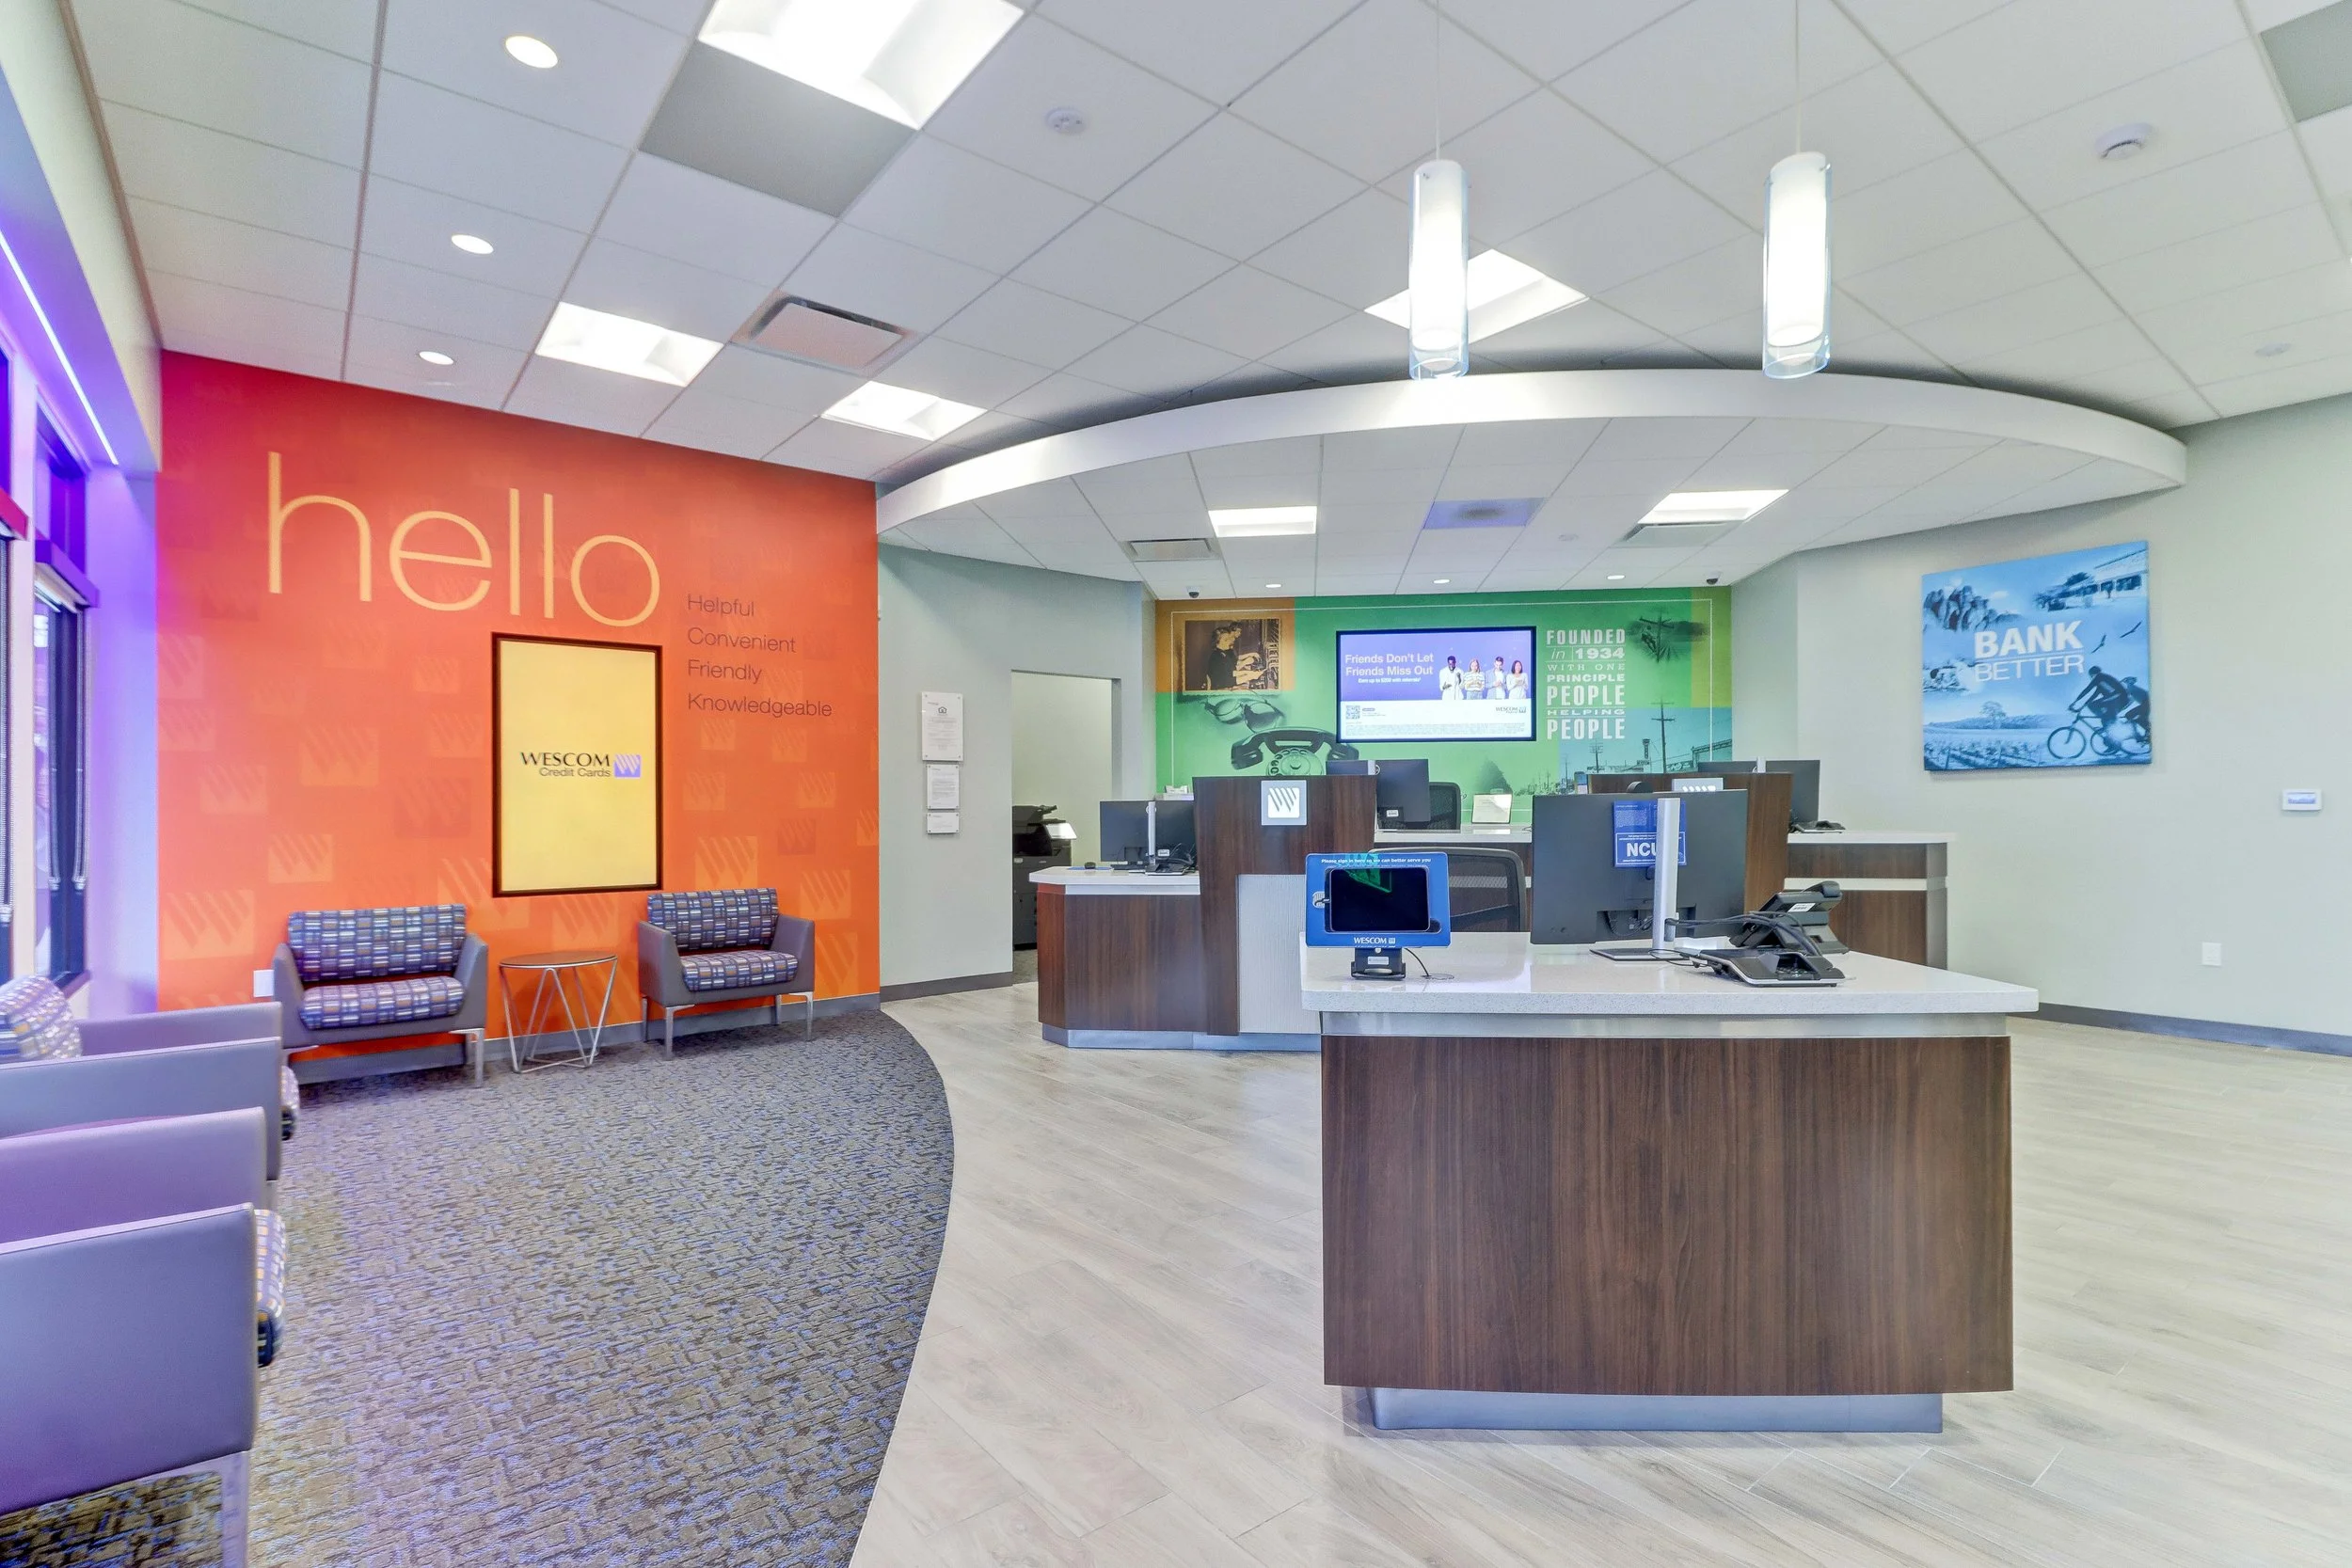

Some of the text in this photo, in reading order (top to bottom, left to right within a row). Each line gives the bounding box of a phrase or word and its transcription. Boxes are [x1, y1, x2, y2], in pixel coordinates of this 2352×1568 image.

[268, 451, 660, 627] hello
[688, 594, 755, 618] Helpful
[688, 626, 796, 653] Convenient
[1546, 628, 1626, 645] FOUNDED
[1975, 620, 2084, 658] BANK
[1345, 653, 1435, 664] Friends Don't Let
[1551, 647, 1626, 659] in 1934
[688, 658, 762, 685] Friendly
[1345, 665, 1434, 676] Friends Miss Out
[1547, 673, 1626, 683] PRINCIPLE
[1975, 654, 2085, 682] BETTER
[688, 692, 833, 719] Knowledgeable
[1547, 685, 1626, 706] PEOPLE
[1547, 718, 1626, 739] PEOPLE
[520, 752, 611, 767] WESCOM
[539, 767, 611, 778] Credit Cards
